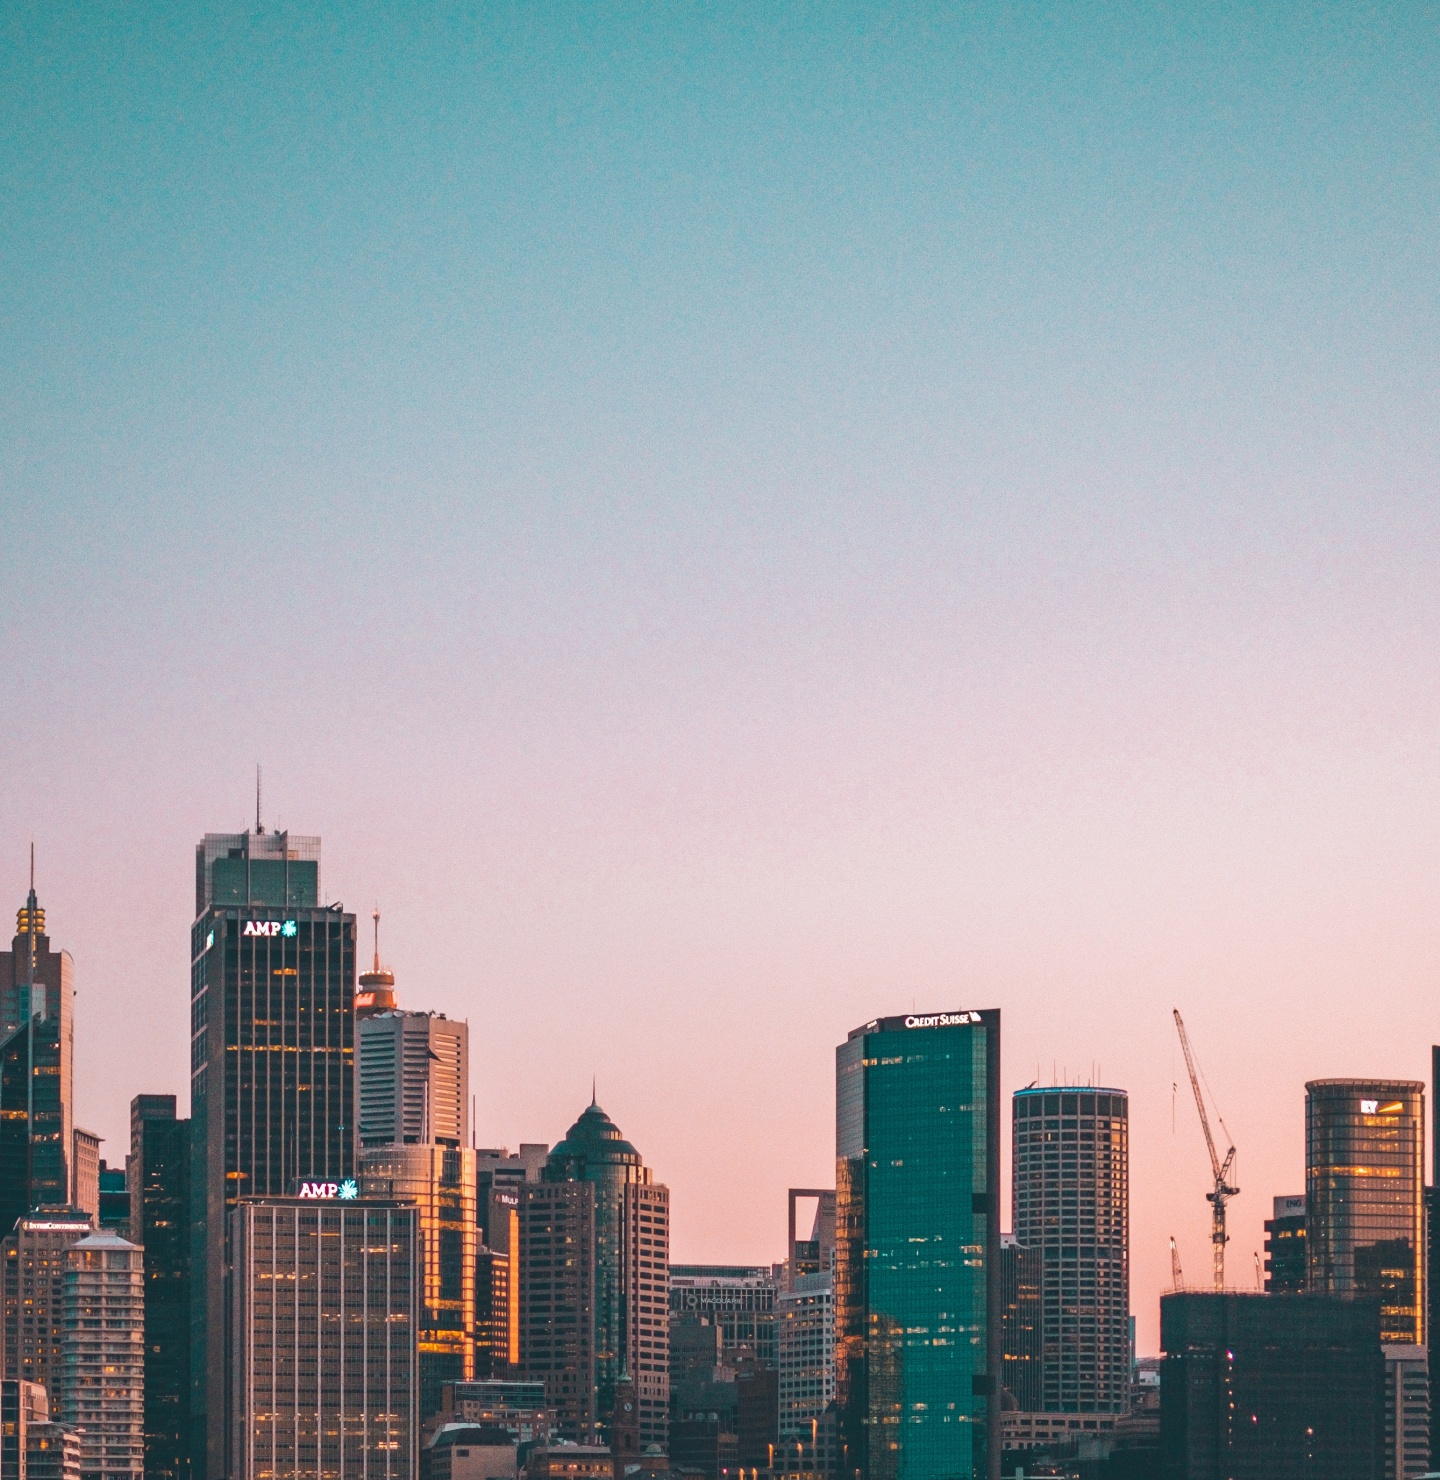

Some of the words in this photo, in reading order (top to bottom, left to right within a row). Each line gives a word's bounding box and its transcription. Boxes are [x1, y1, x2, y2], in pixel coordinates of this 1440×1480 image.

[243, 921, 281, 936] AMP
[905, 1016, 940, 1028] CREDIT
[940, 1014, 969, 1025] SUISSE
[299, 1182, 338, 1198] AMP
